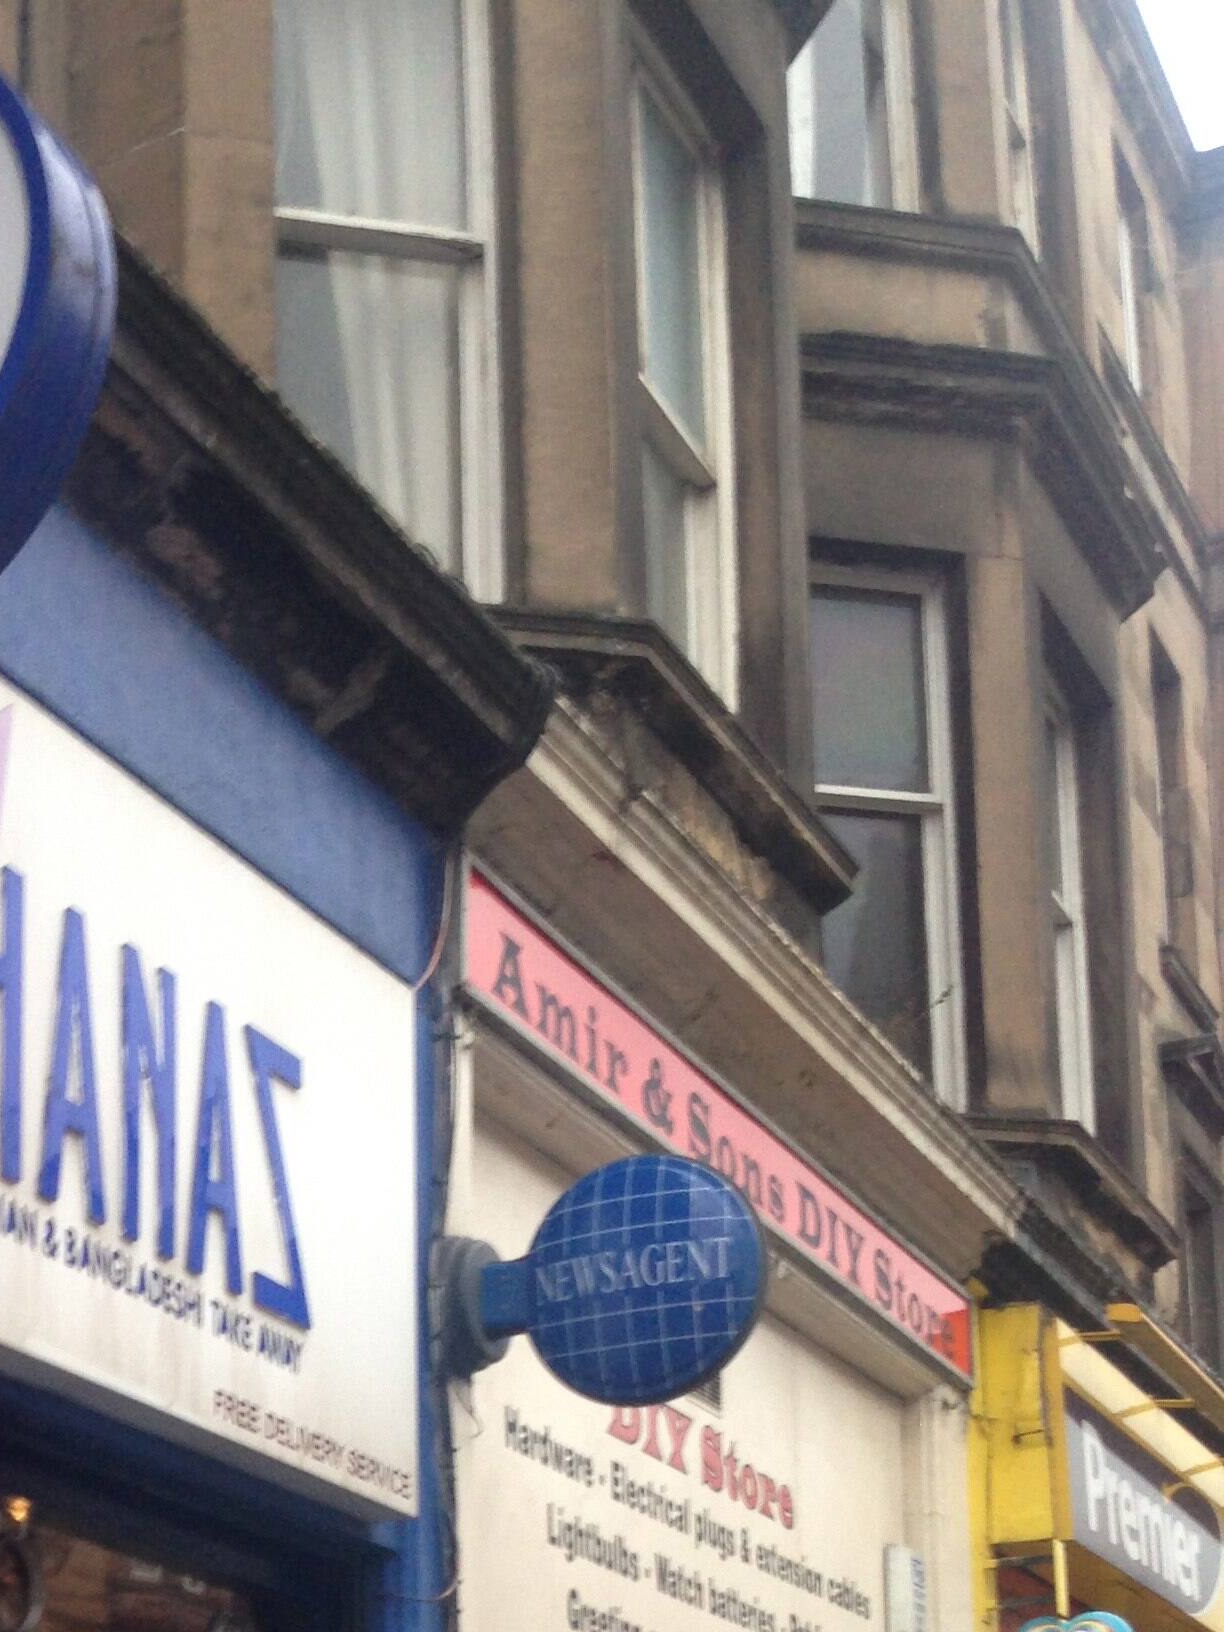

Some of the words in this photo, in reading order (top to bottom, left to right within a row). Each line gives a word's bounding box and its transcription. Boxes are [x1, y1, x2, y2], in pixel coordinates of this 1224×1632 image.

[492, 930, 629, 1097] Amir
[642, 1058, 673, 1136] &
[687, 1091, 786, 1224] Sons
[795, 1179, 865, 1284] DIY
[875, 1248, 954, 1362] Store
[43, 1217, 60, 1260] &
[211, 1298, 252, 1354] TAKE
[257, 1325, 303, 1374] AWAY
[534, 1236, 733, 1302] NEWSAGENT
[212, 1389, 259, 1437] FREE
[264, 1410, 347, 1467] DELIVERY
[347, 1447, 412, 1501] SERVICE
[504, 1405, 595, 1488] Hardware
[611, 1460, 690, 1535] Electrical
[694, 1507, 735, 1561] plugs
[740, 1527, 750, 1564] &
[756, 1543, 823, 1598] extension
[607, 1404, 693, 1475] DIY
[702, 1425, 794, 1530] Store
[1080, 1418, 1201, 1603] Premier
[546, 1502, 640, 1582] Lightbulbs
[654, 1552, 705, 1611] Watch
